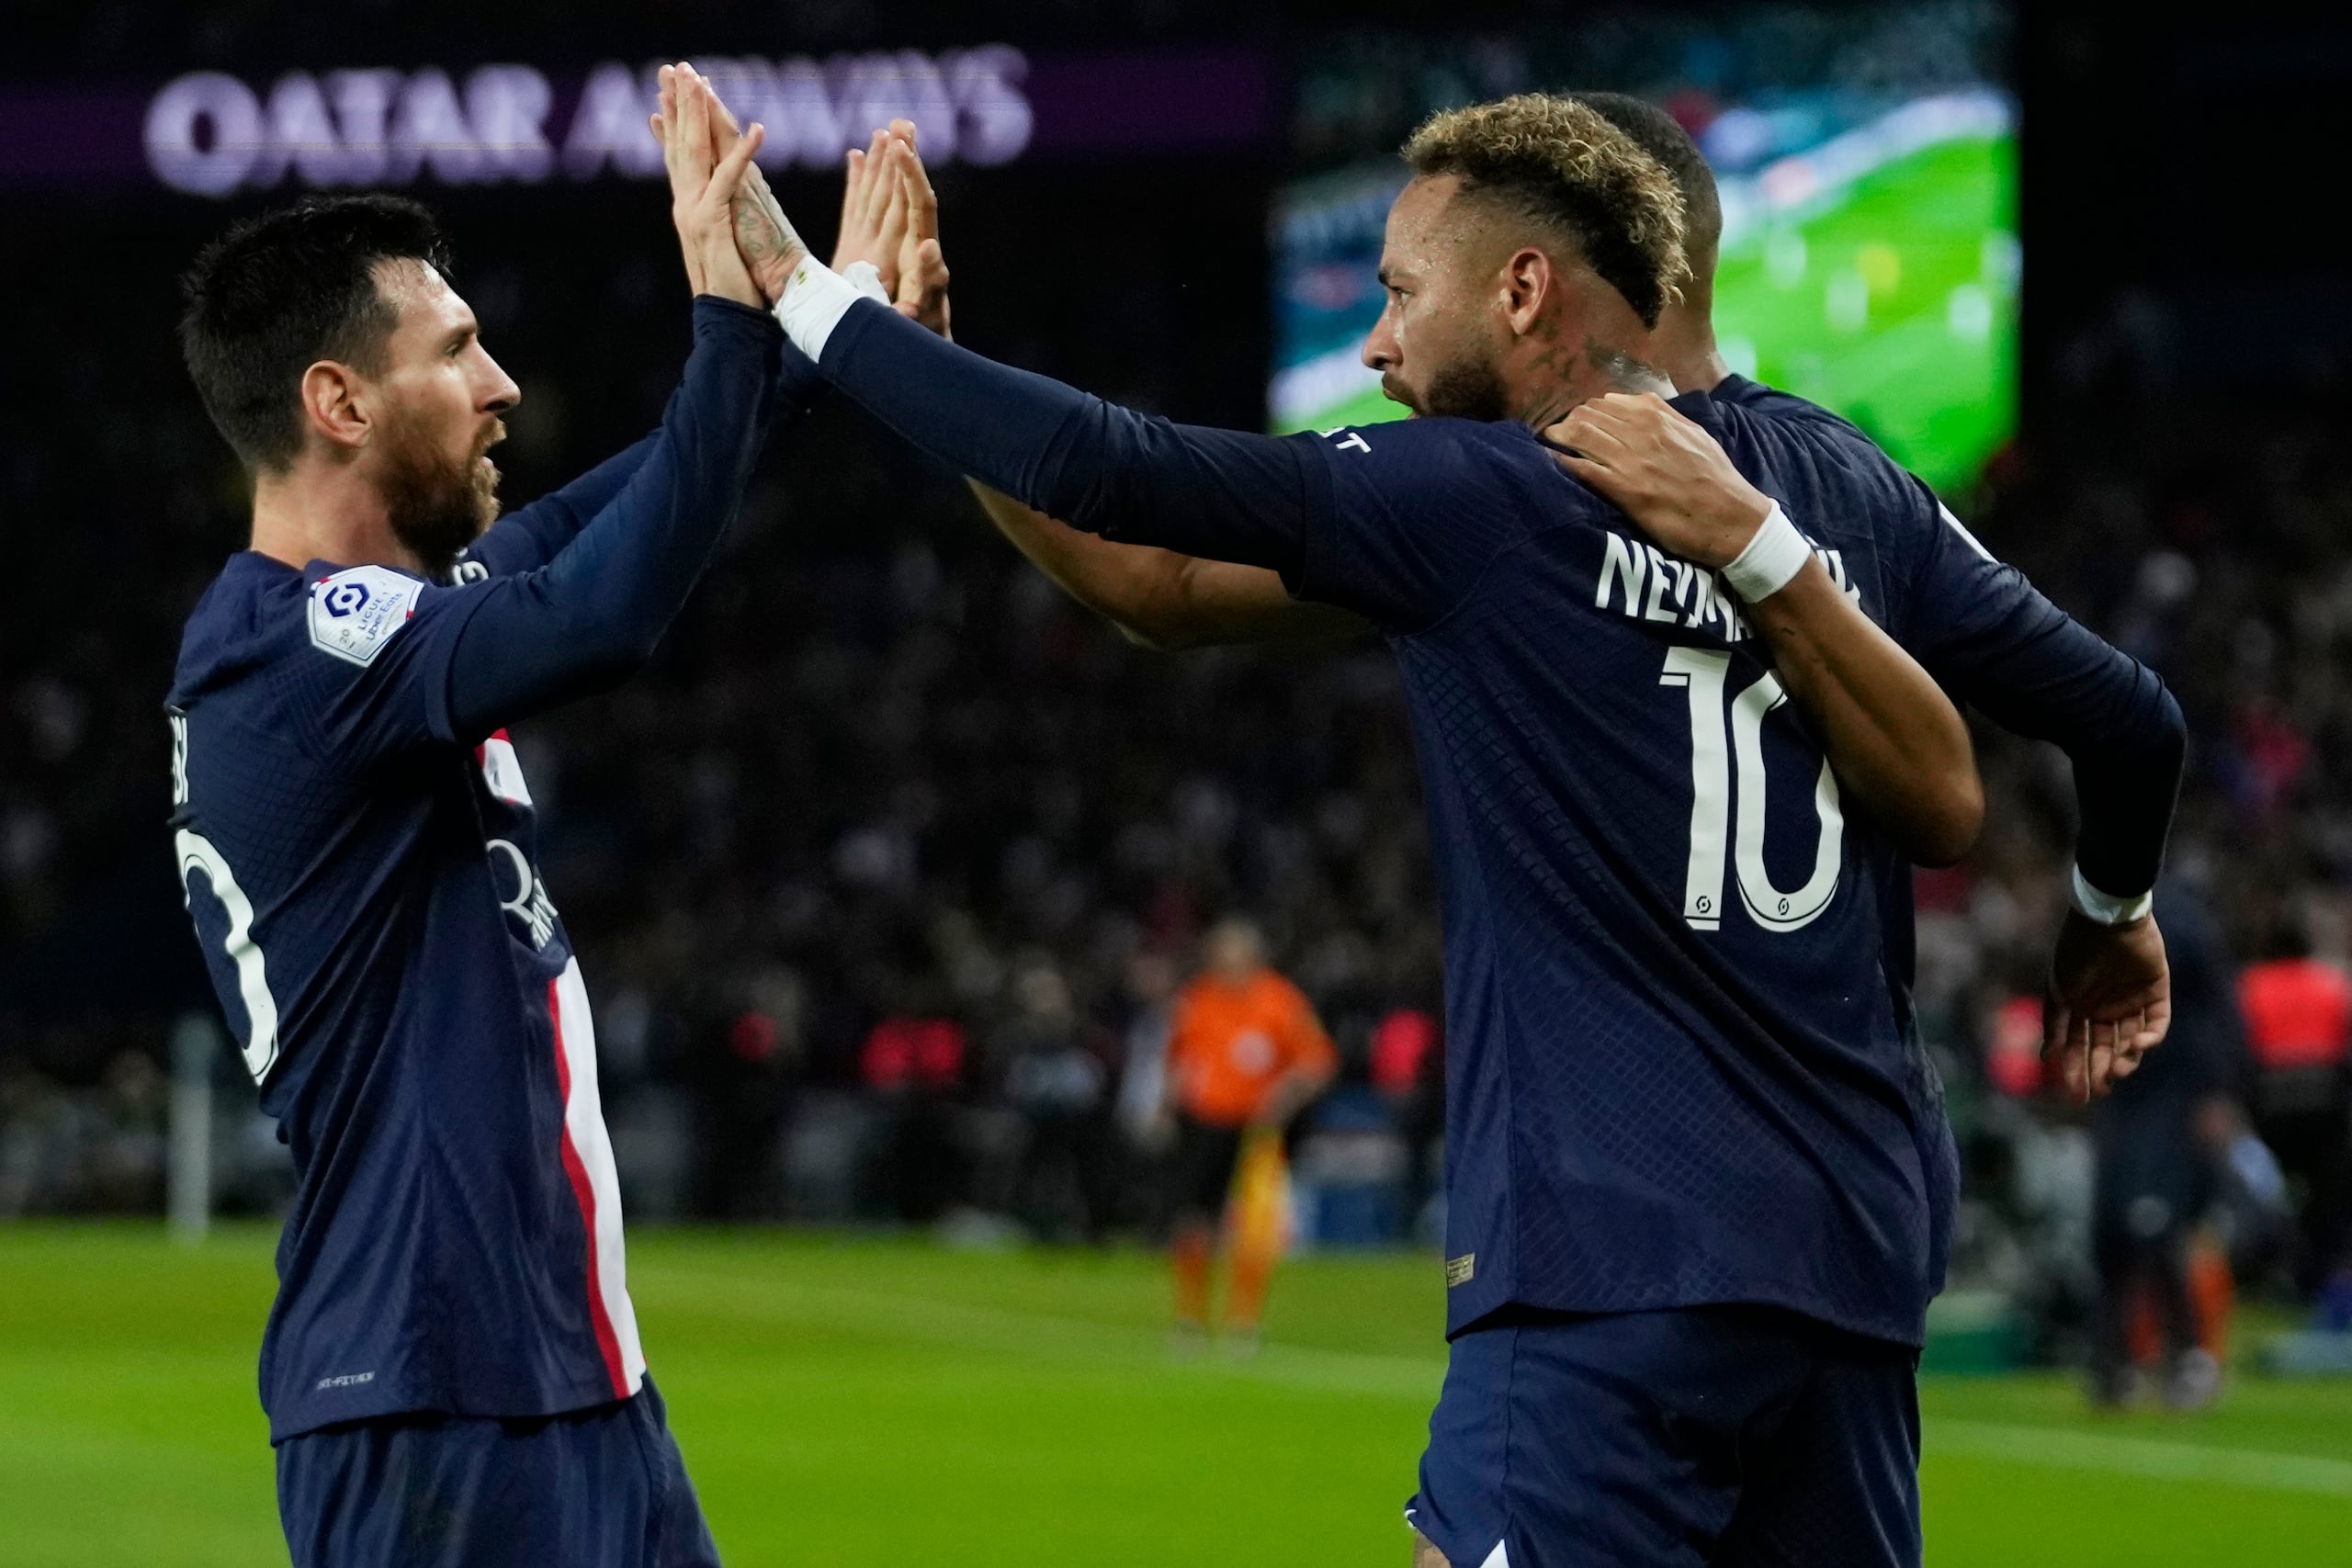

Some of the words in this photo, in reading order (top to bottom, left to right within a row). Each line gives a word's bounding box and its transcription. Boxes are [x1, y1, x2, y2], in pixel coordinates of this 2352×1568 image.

[144, 65, 551, 196] QATAR
[561, 43, 1034, 181] AWAYS
[358, 598, 382, 631] LIGUE
[367, 615, 384, 641] Uber
[379, 592, 403, 613] Eats
[1659, 647, 1844, 932] 10
